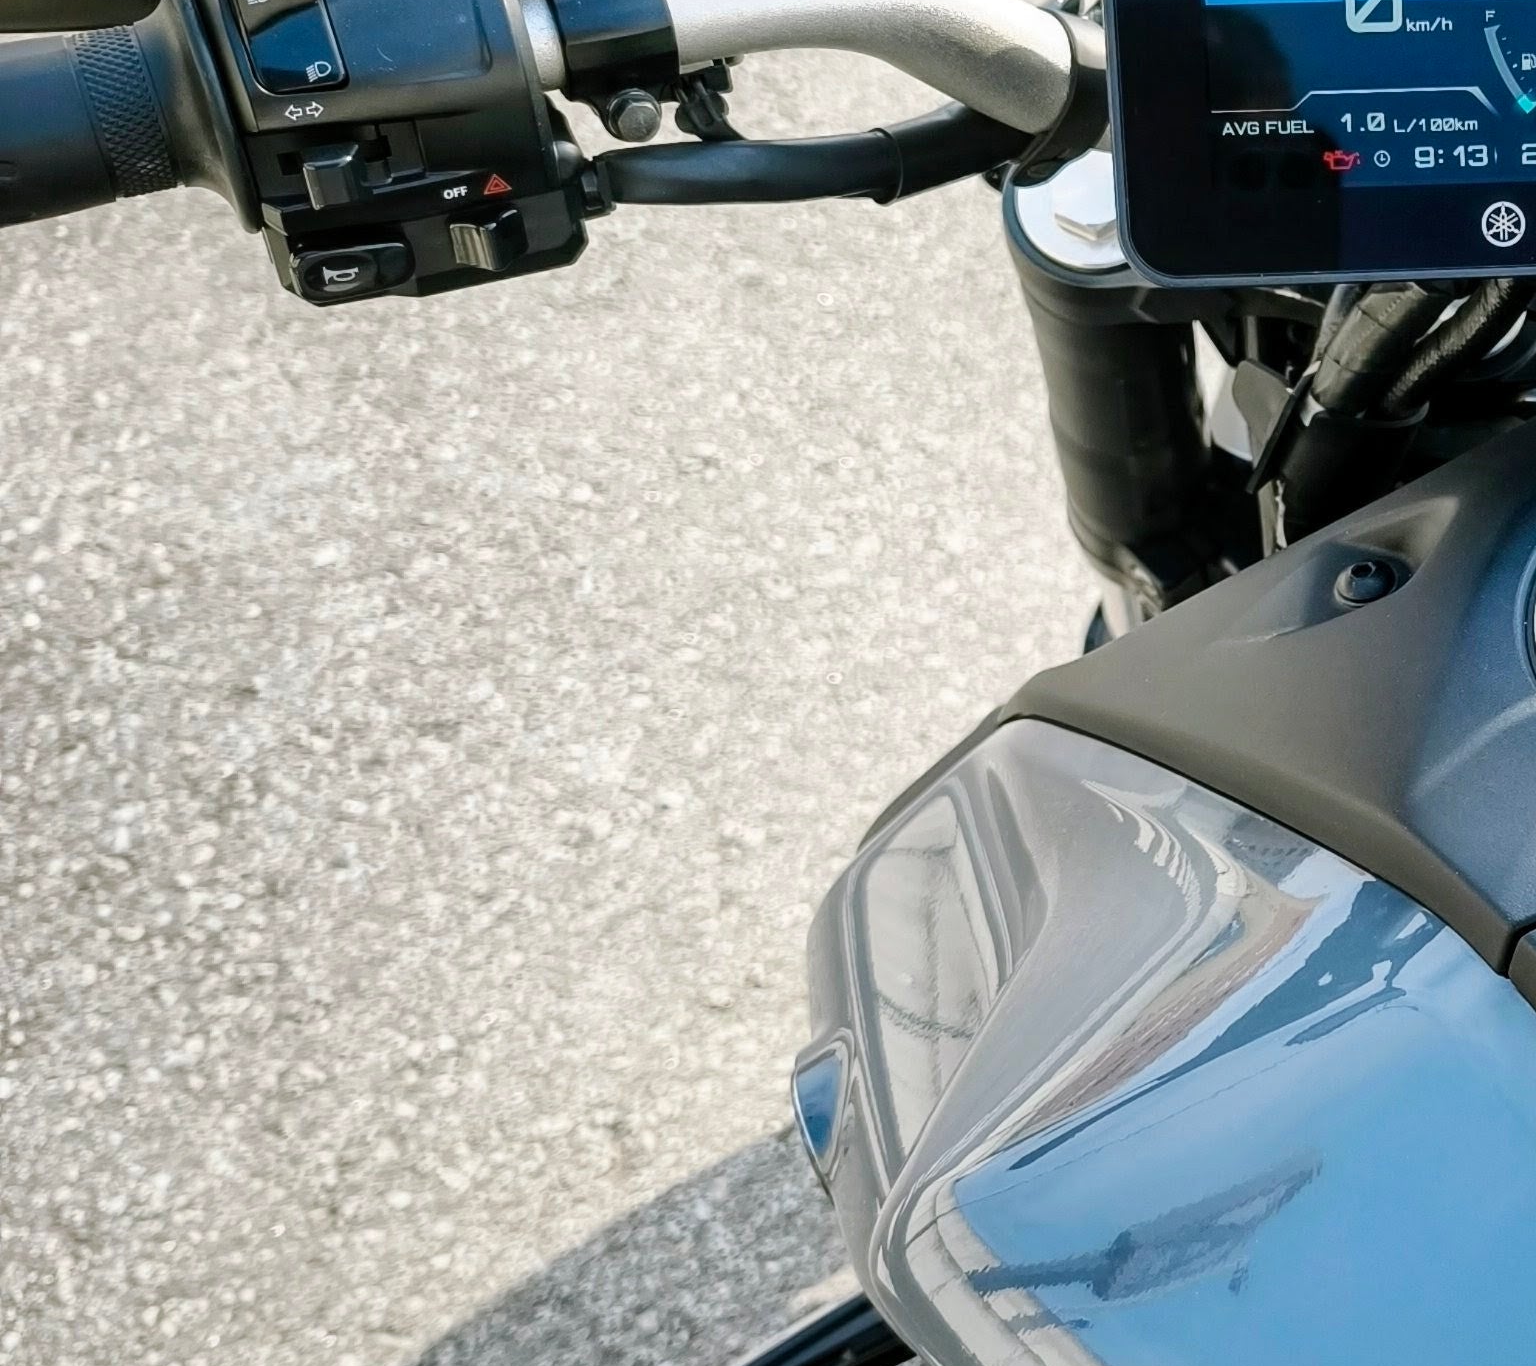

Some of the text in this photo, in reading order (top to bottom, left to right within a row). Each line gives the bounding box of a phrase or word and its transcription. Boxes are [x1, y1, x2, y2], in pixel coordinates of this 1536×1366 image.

[1485, 10, 1496, 22] F
[1405, 17, 1453, 32] km/h
[1222, 112, 1478, 136] AVG FUEL 1.0 L/100km
[1414, 144, 1489, 168] 9:13
[443, 185, 468, 200] OFF
